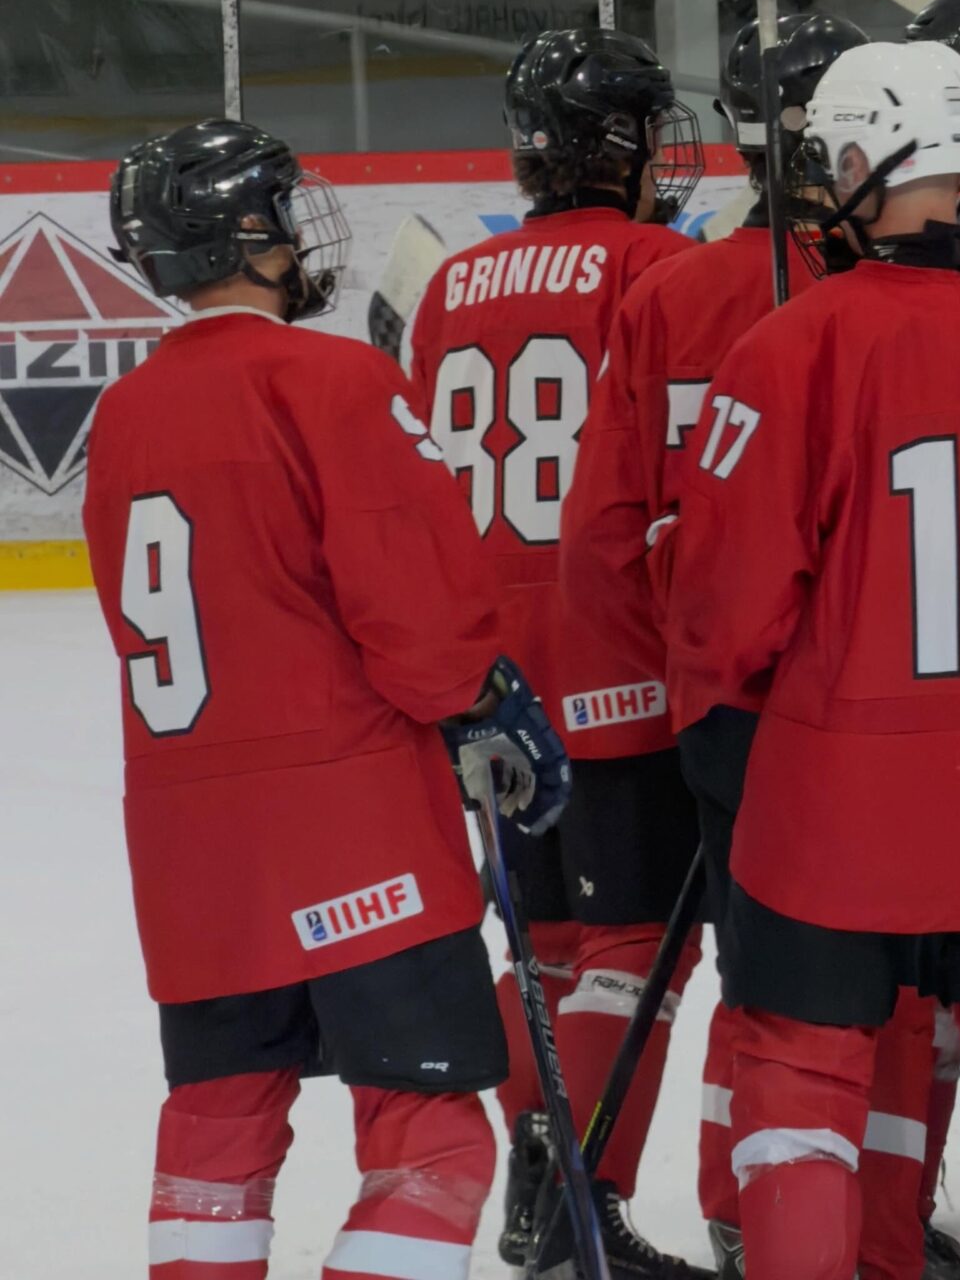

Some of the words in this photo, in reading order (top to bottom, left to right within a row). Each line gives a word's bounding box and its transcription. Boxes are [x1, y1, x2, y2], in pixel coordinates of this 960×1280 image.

[445, 245, 607, 312] GRINIUS
[699, 394, 761, 481] 17
[120, 489, 212, 738] 9
[591, 685, 657, 721] IIHF
[327, 881, 408, 935] IIHF
